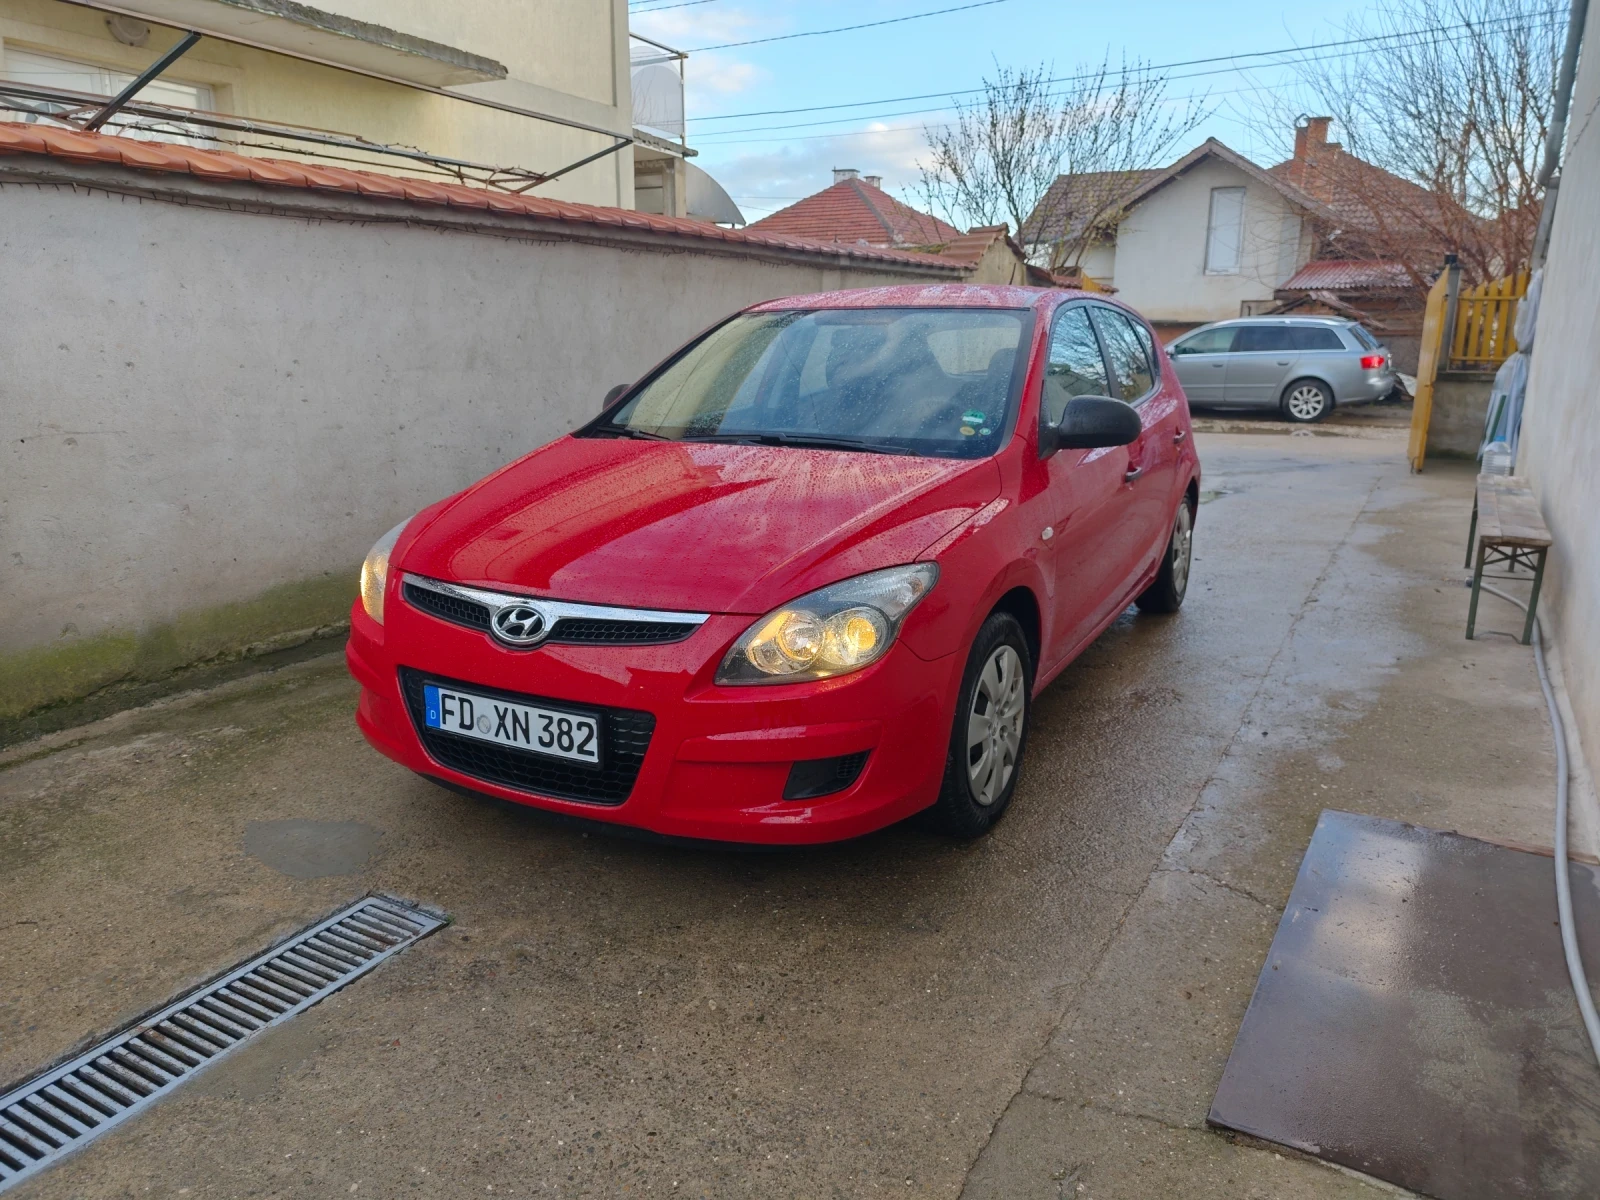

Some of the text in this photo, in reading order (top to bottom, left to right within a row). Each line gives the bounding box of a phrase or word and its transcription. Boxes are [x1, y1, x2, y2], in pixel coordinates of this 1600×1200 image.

[430, 710, 436, 719] D
[441, 694, 595, 757] FD XN 382
